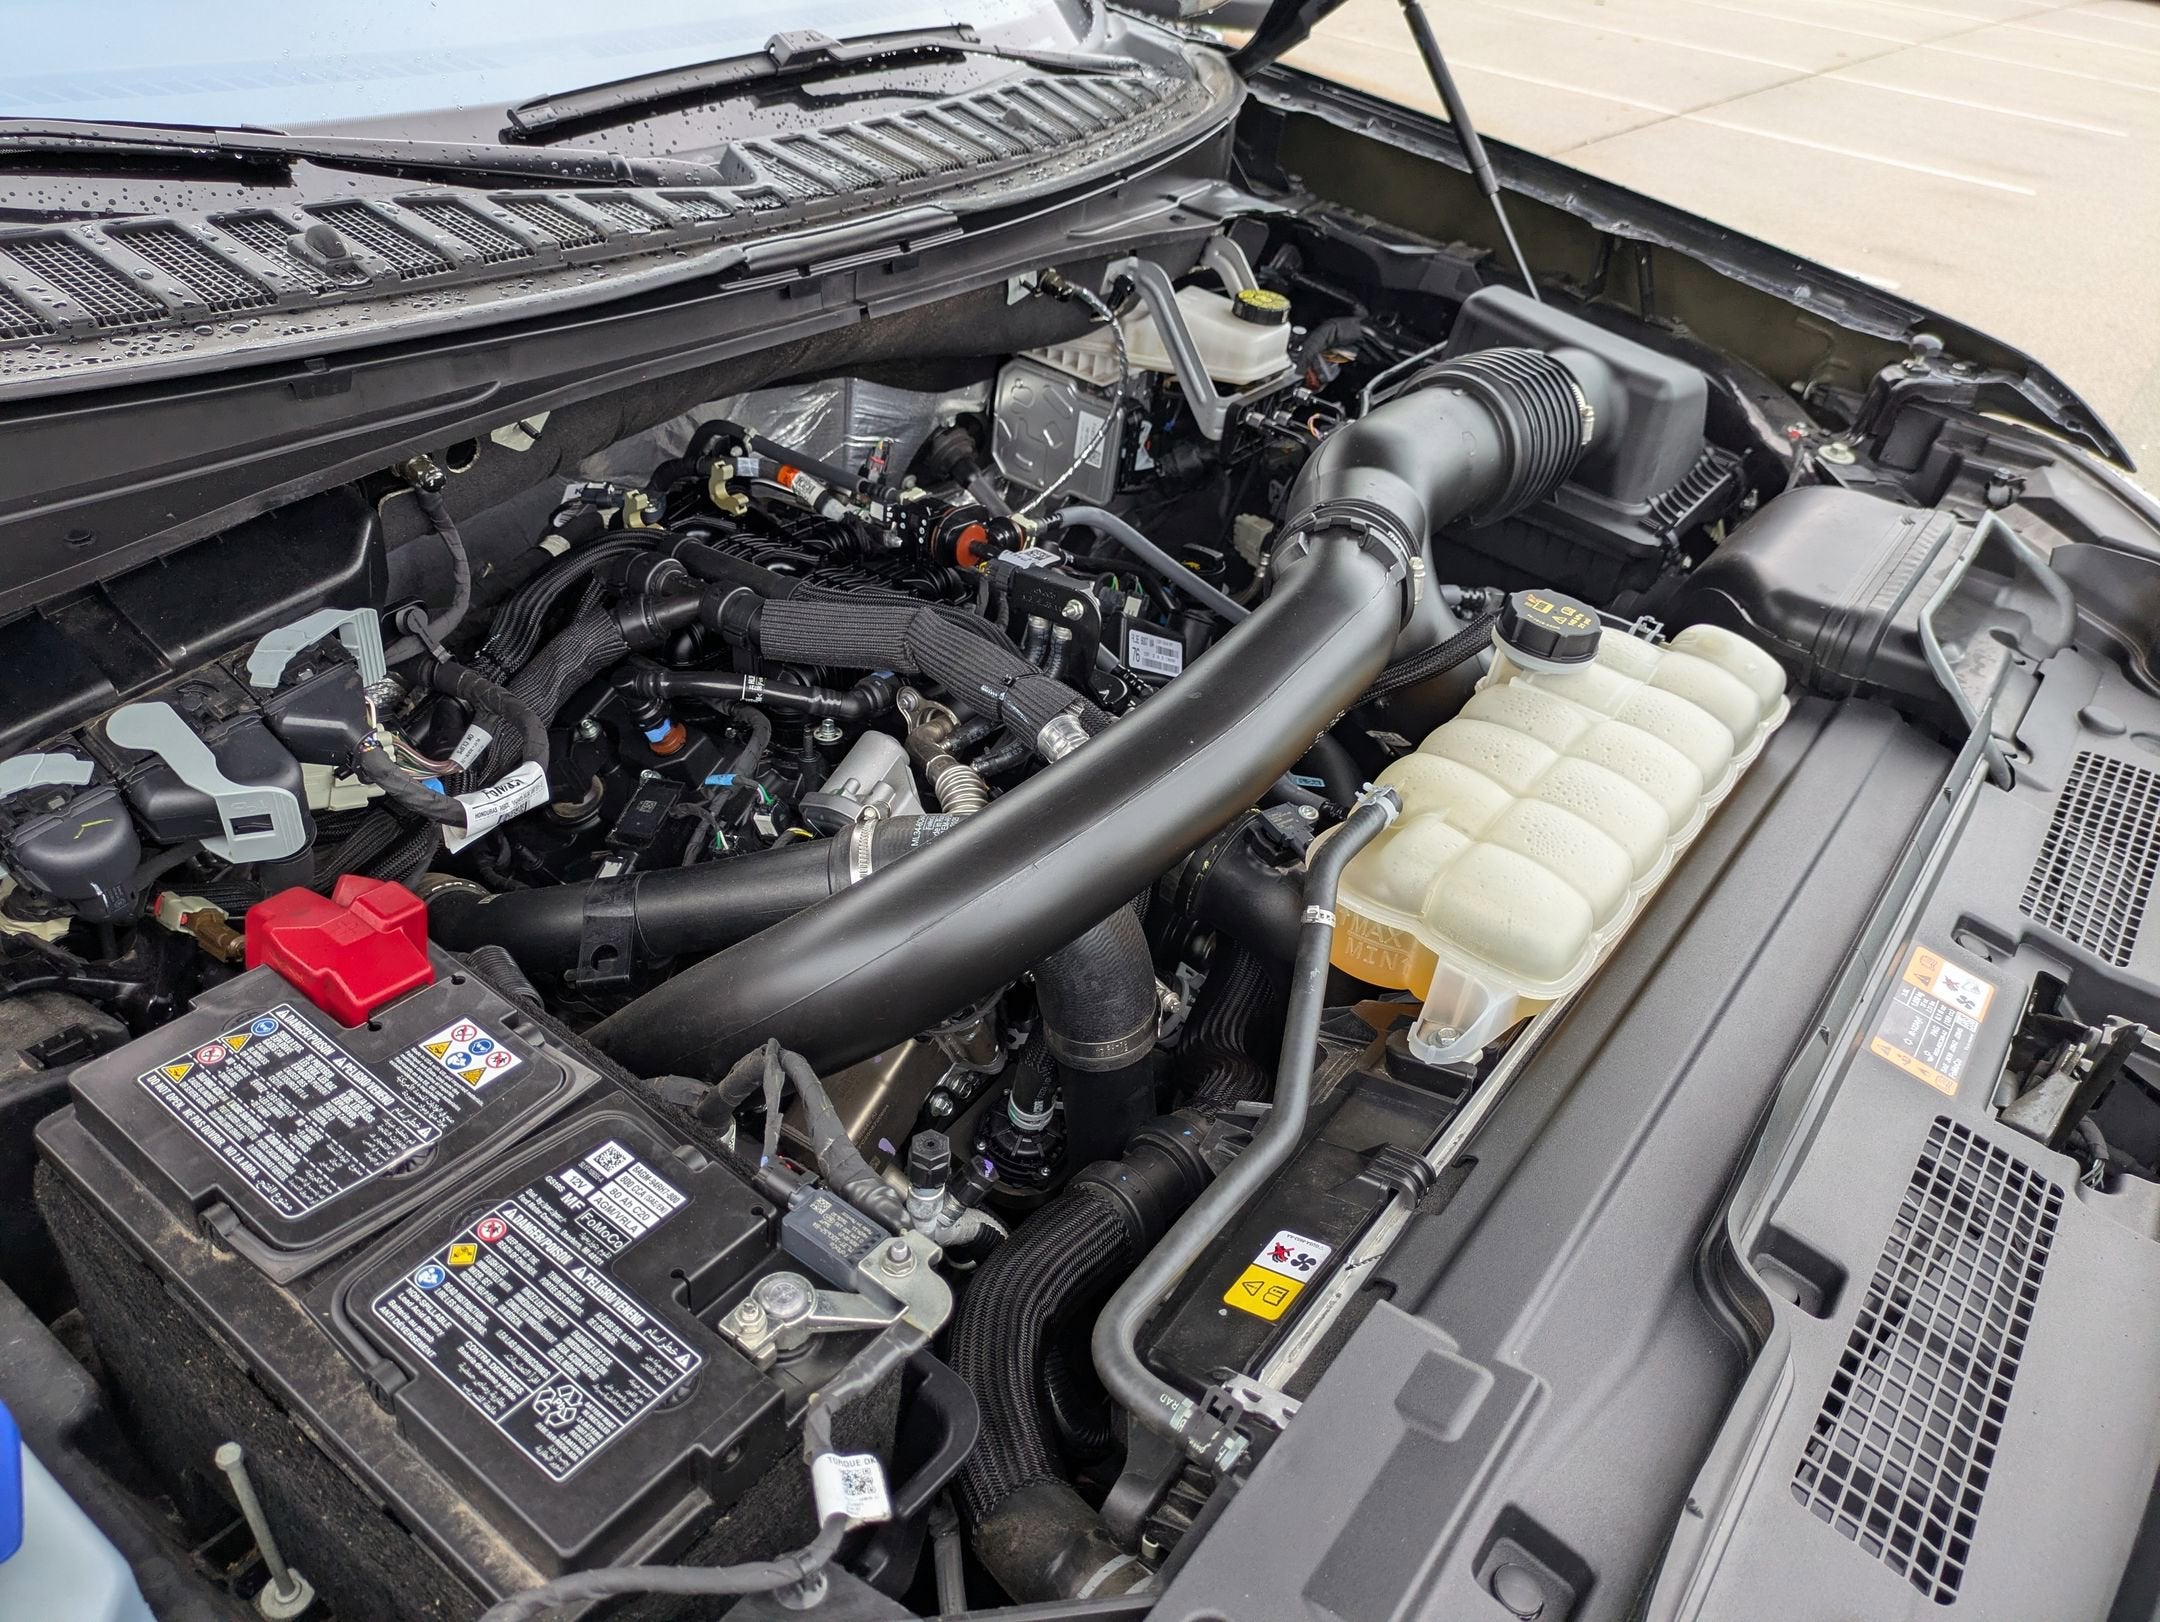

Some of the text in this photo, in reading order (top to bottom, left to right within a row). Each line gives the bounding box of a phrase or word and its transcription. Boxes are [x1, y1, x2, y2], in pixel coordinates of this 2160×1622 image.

[1349, 913, 1402, 948] MAX
[1344, 938, 1399, 970] MIN
[282, 1014, 336, 1056] DANGER/POISON
[339, 1062, 396, 1106] PELIGRO/VENENO
[145, 1074, 188, 1110] DO NOT OPEN.
[180, 1108, 229, 1148] NE PAS OUVRIR.
[222, 1145, 263, 1179] NO LA ABRA.
[567, 1174, 587, 1189] 12V
[558, 1191, 587, 1213] MF
[592, 1195, 640, 1233] AGM/VRLA
[608, 1187, 651, 1221] 80 Ah C20
[618, 1174, 669, 1215] 800 CCA (SAE/EN)
[579, 1211, 627, 1250] FoMoCo
[510, 1213, 574, 1266] DANGER/POISON
[580, 1272, 647, 1327] PELIGRO/VENENO
[386, 1298, 436, 1345] Batterie au plomb
[396, 1292, 446, 1337] Lead Acid Battery
[404, 1286, 453, 1330] NON-SPILLABLE
[433, 1286, 489, 1337] LIRE LES INSTRUCTIONS.
[441, 1281, 491, 1324] READ INSTRUCTIONS.
[378, 1304, 438, 1359] ANTI DÉVERSEMENT
[463, 1339, 524, 1395] CONTRA DERRAMES
[494, 1328, 552, 1379] LEA LAS INSTRUCCIONES.
[551, 1397, 567, 1411] Pb
[1159, 1393, 1179, 1411] RAD
